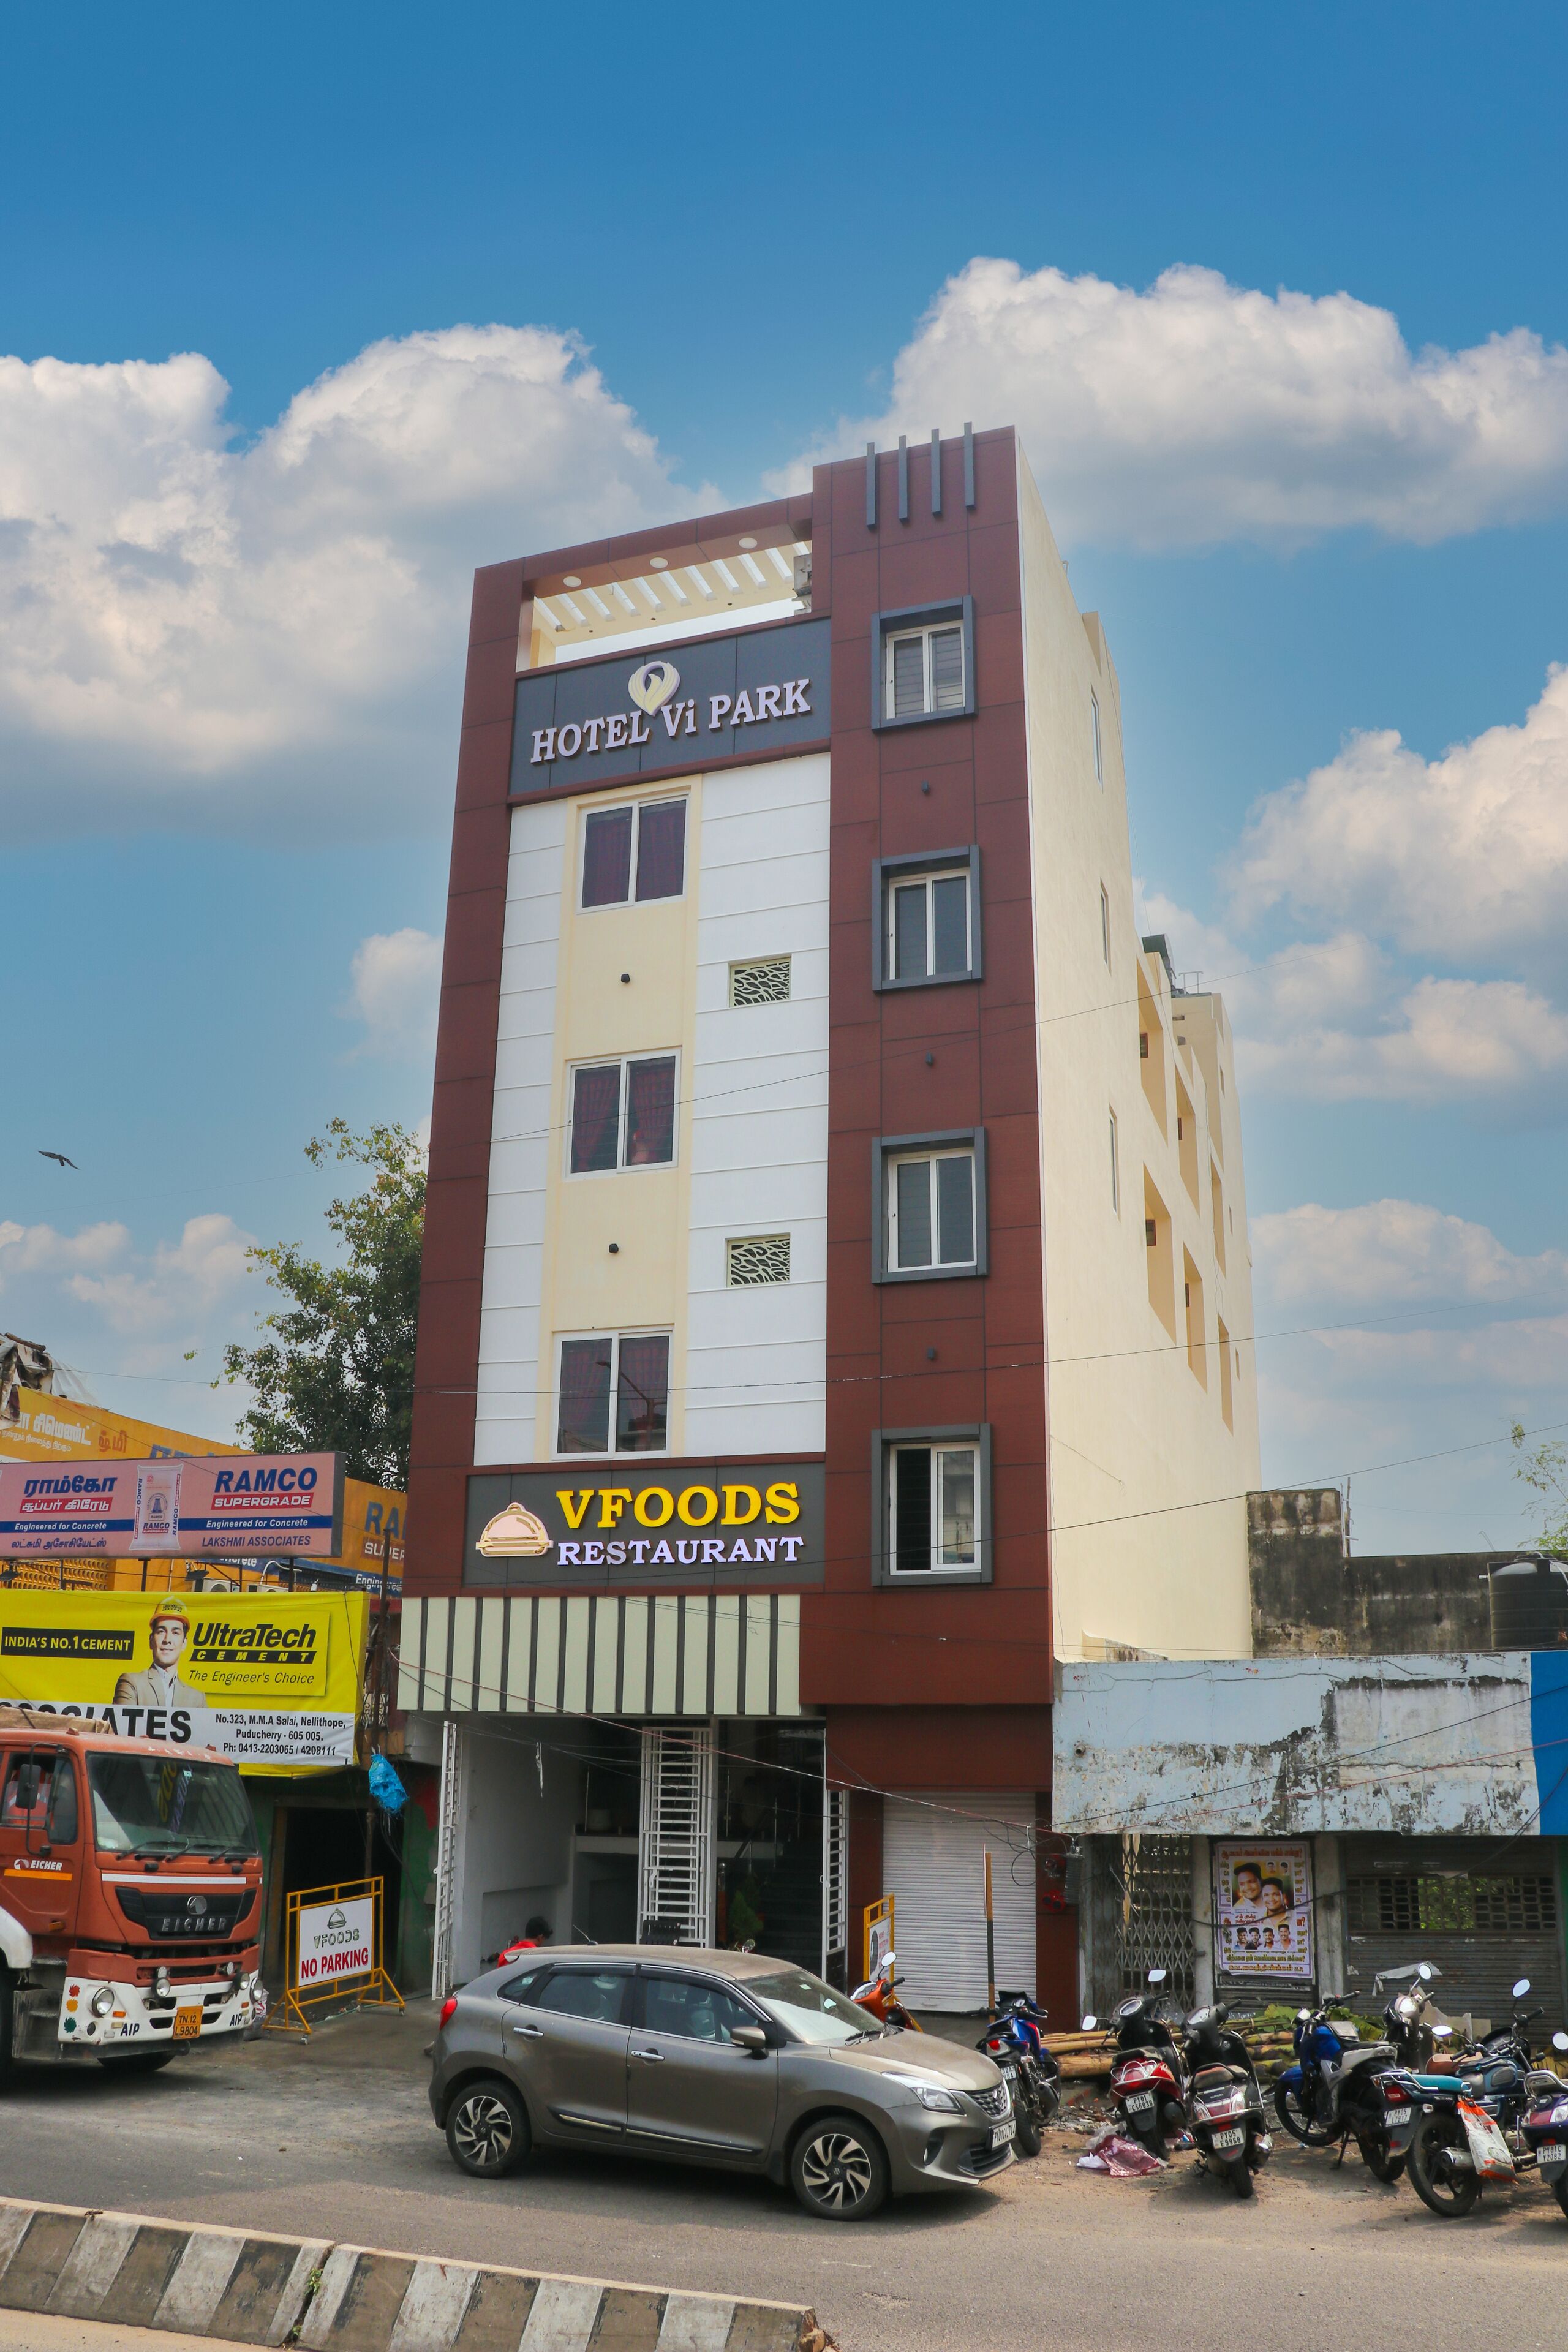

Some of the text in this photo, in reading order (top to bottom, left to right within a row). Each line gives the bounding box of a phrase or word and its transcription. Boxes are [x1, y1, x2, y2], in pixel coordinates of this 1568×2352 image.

[530, 679, 811, 763] HOTEL Vi PARK
[24, 1475, 118, 1498] ராம்கோ
[214, 1468, 317, 1493] RAMCO
[22, 1499, 109, 1512] சூப்பர் கிரேடு
[214, 1496, 311, 1507] SUPERGRADE
[556, 1482, 801, 1528] VFOODS
[15, 1523, 58, 1532] Engineered
[206, 1519, 252, 1529] Engineered
[270, 1518, 308, 1527] Concrete
[12, 1538, 42, 1548] லட்சுமி
[202, 1536, 311, 1547] LAKSHMI ASSOCIATES
[557, 1536, 804, 1566] RESTAURANT
[193, 1623, 317, 1648] UltraTech
[4, 1636, 47, 1648] INDIA'S
[81, 1638, 131, 1651] CEMENT
[197, 1651, 309, 1662] CEMENT
[189, 1670, 314, 1686] The Engineer's Choice
[216, 1714, 346, 1729] No.323, M.M.A Salai, Nellithope,
[236, 1729, 282, 1741] Puducherry
[288, 1731, 303, 1740] 605
[306, 1732, 323, 1741] 005.
[223, 1743, 236, 1752] Ph:
[238, 1743, 293, 1754] 0413-2203065
[301, 1746, 336, 1755] 4208111
[31, 1860, 62, 1871] EICHER
[161, 1918, 227, 1932] EICHER
[314, 1929, 360, 1949] VFOODS
[301, 1947, 369, 1979] NO PARKING
[230, 2014, 243, 2026] AIP
[121, 2023, 140, 2036] AIP
[175, 2026, 198, 2036] L9804
[1134, 2095, 1147, 2103] PY01
[1220, 2130, 1236, 2140] PY05
[1220, 2136, 1241, 2147] E9968
